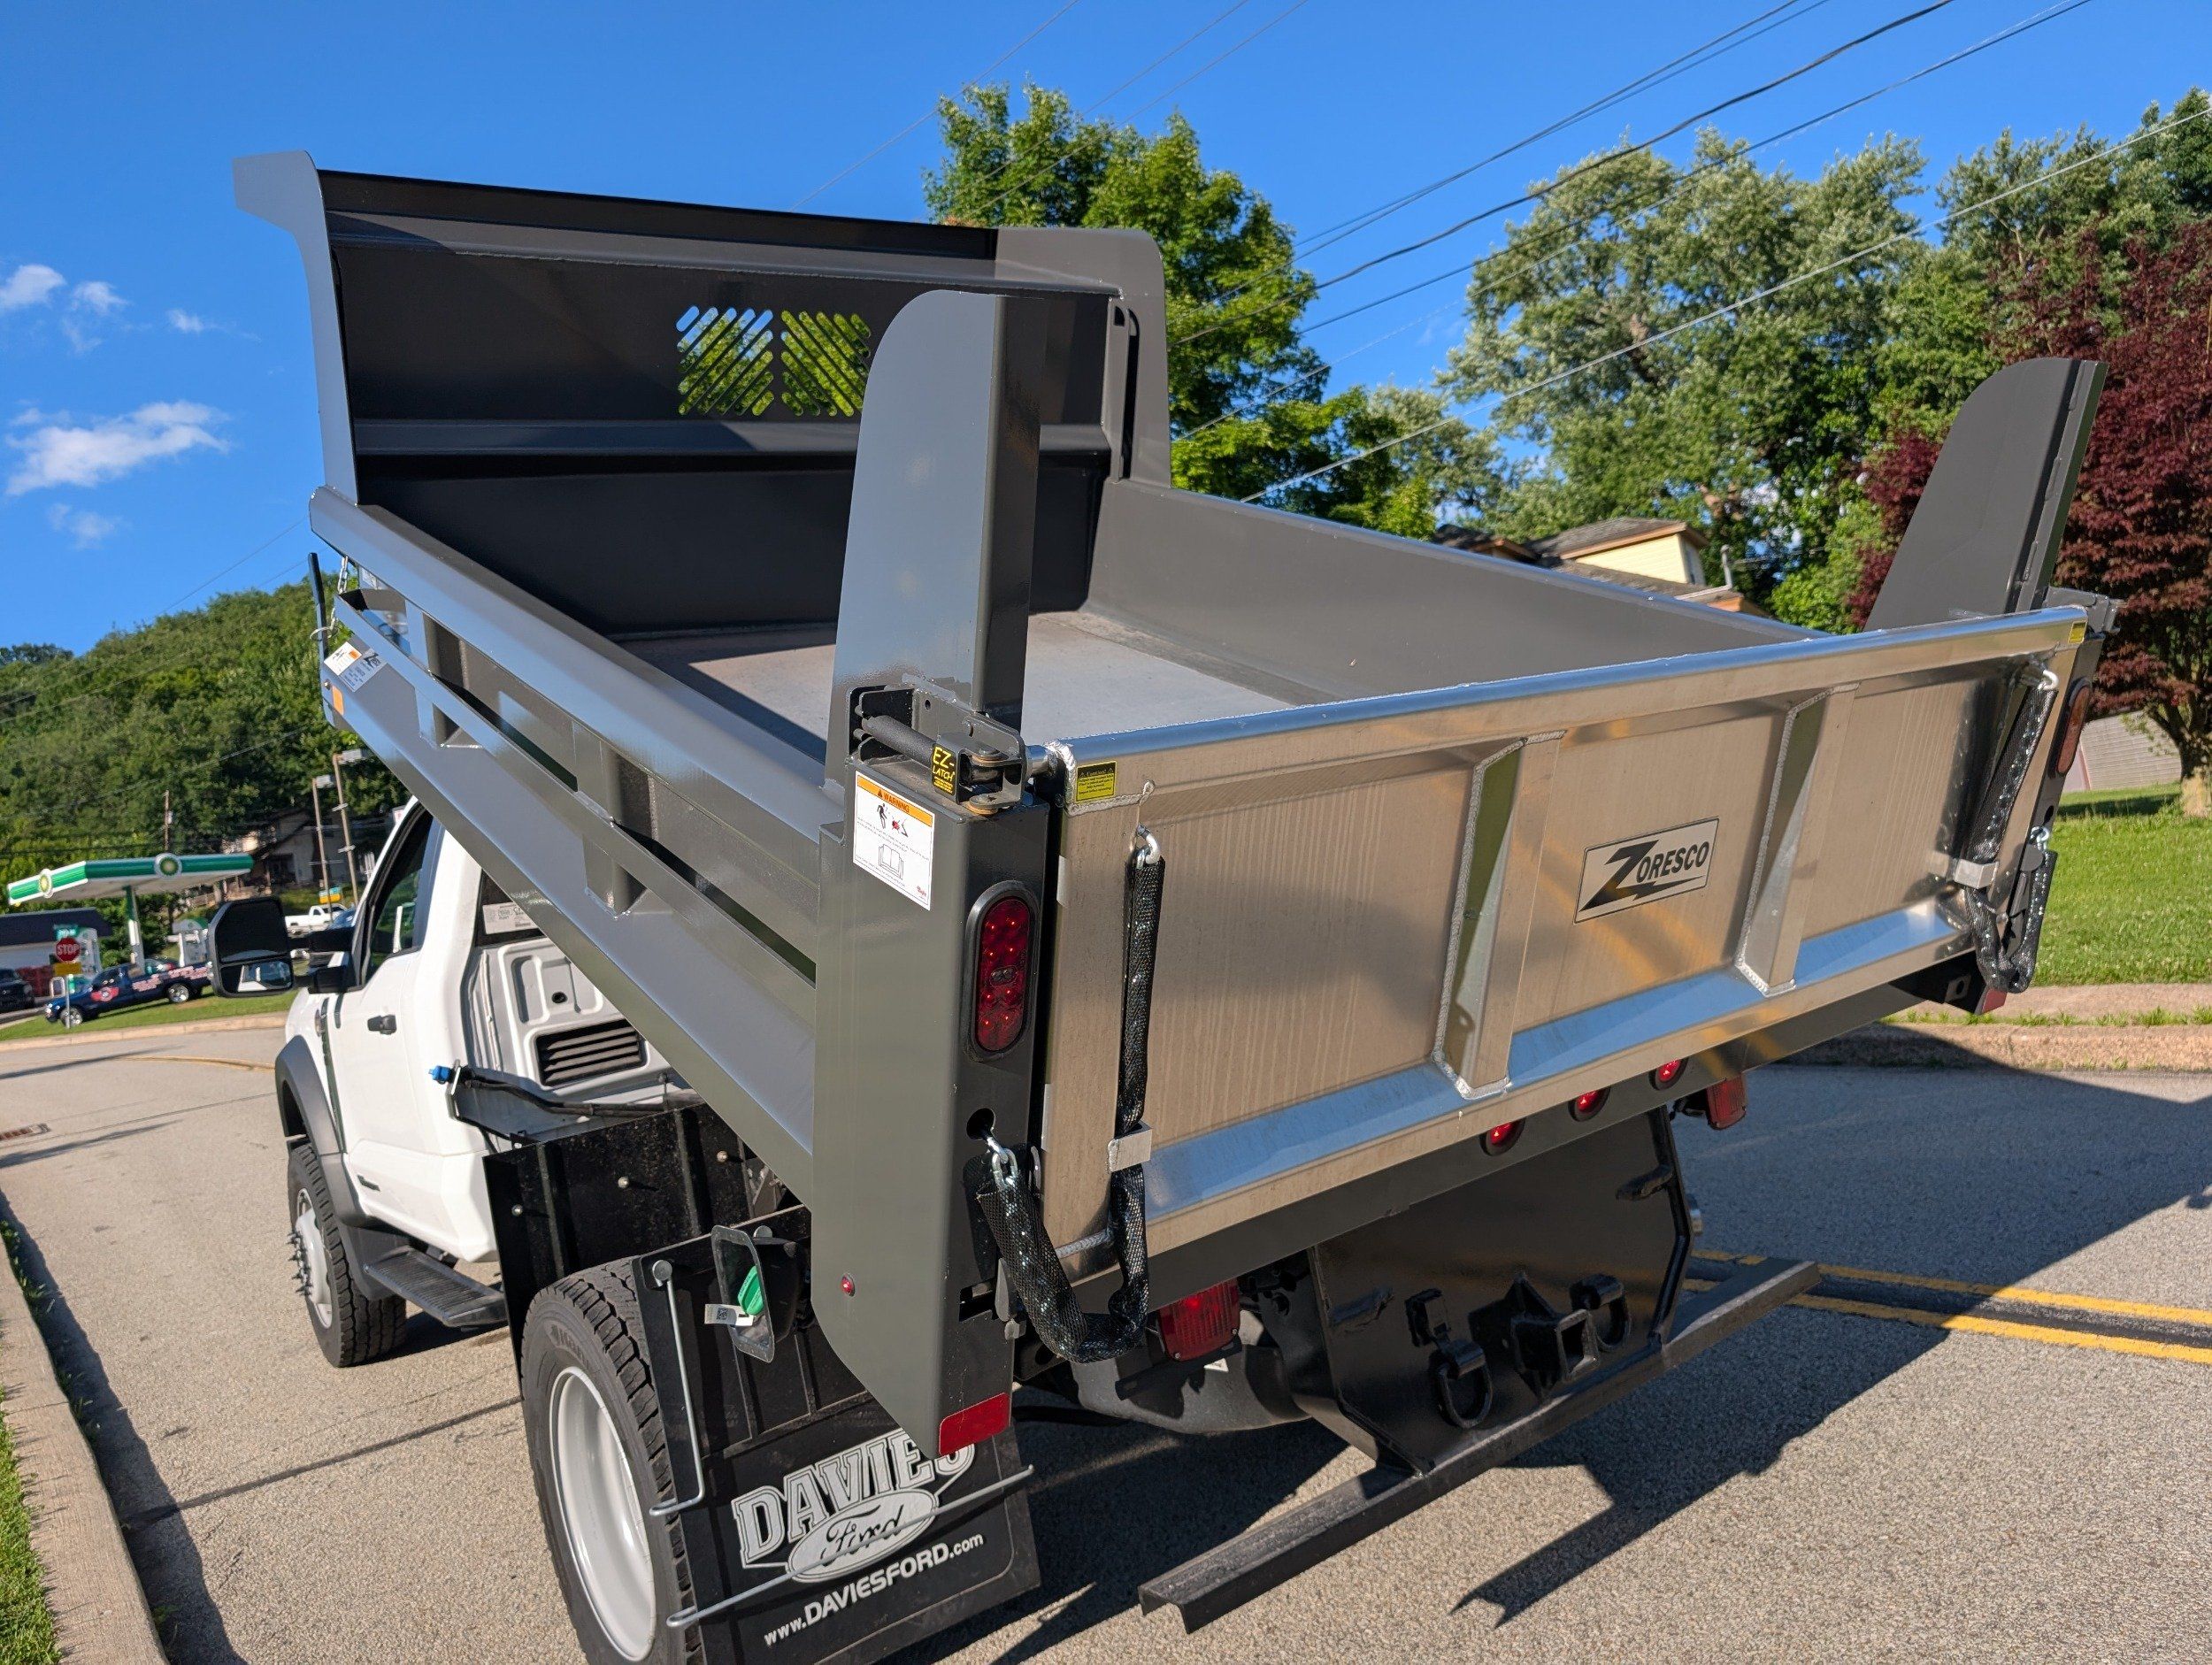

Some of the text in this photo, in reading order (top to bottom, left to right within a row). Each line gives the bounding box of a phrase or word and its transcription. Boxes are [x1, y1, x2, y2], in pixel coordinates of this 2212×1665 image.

[932, 764, 954, 782] LATCH
[884, 790, 910, 813] WARNING
[1578, 839, 1709, 913] ZORESCO
[57, 943, 80, 955] STOP
[819, 1503, 904, 1568] Ford
[764, 1531, 984, 1647] www.DAVIESFORD.com
